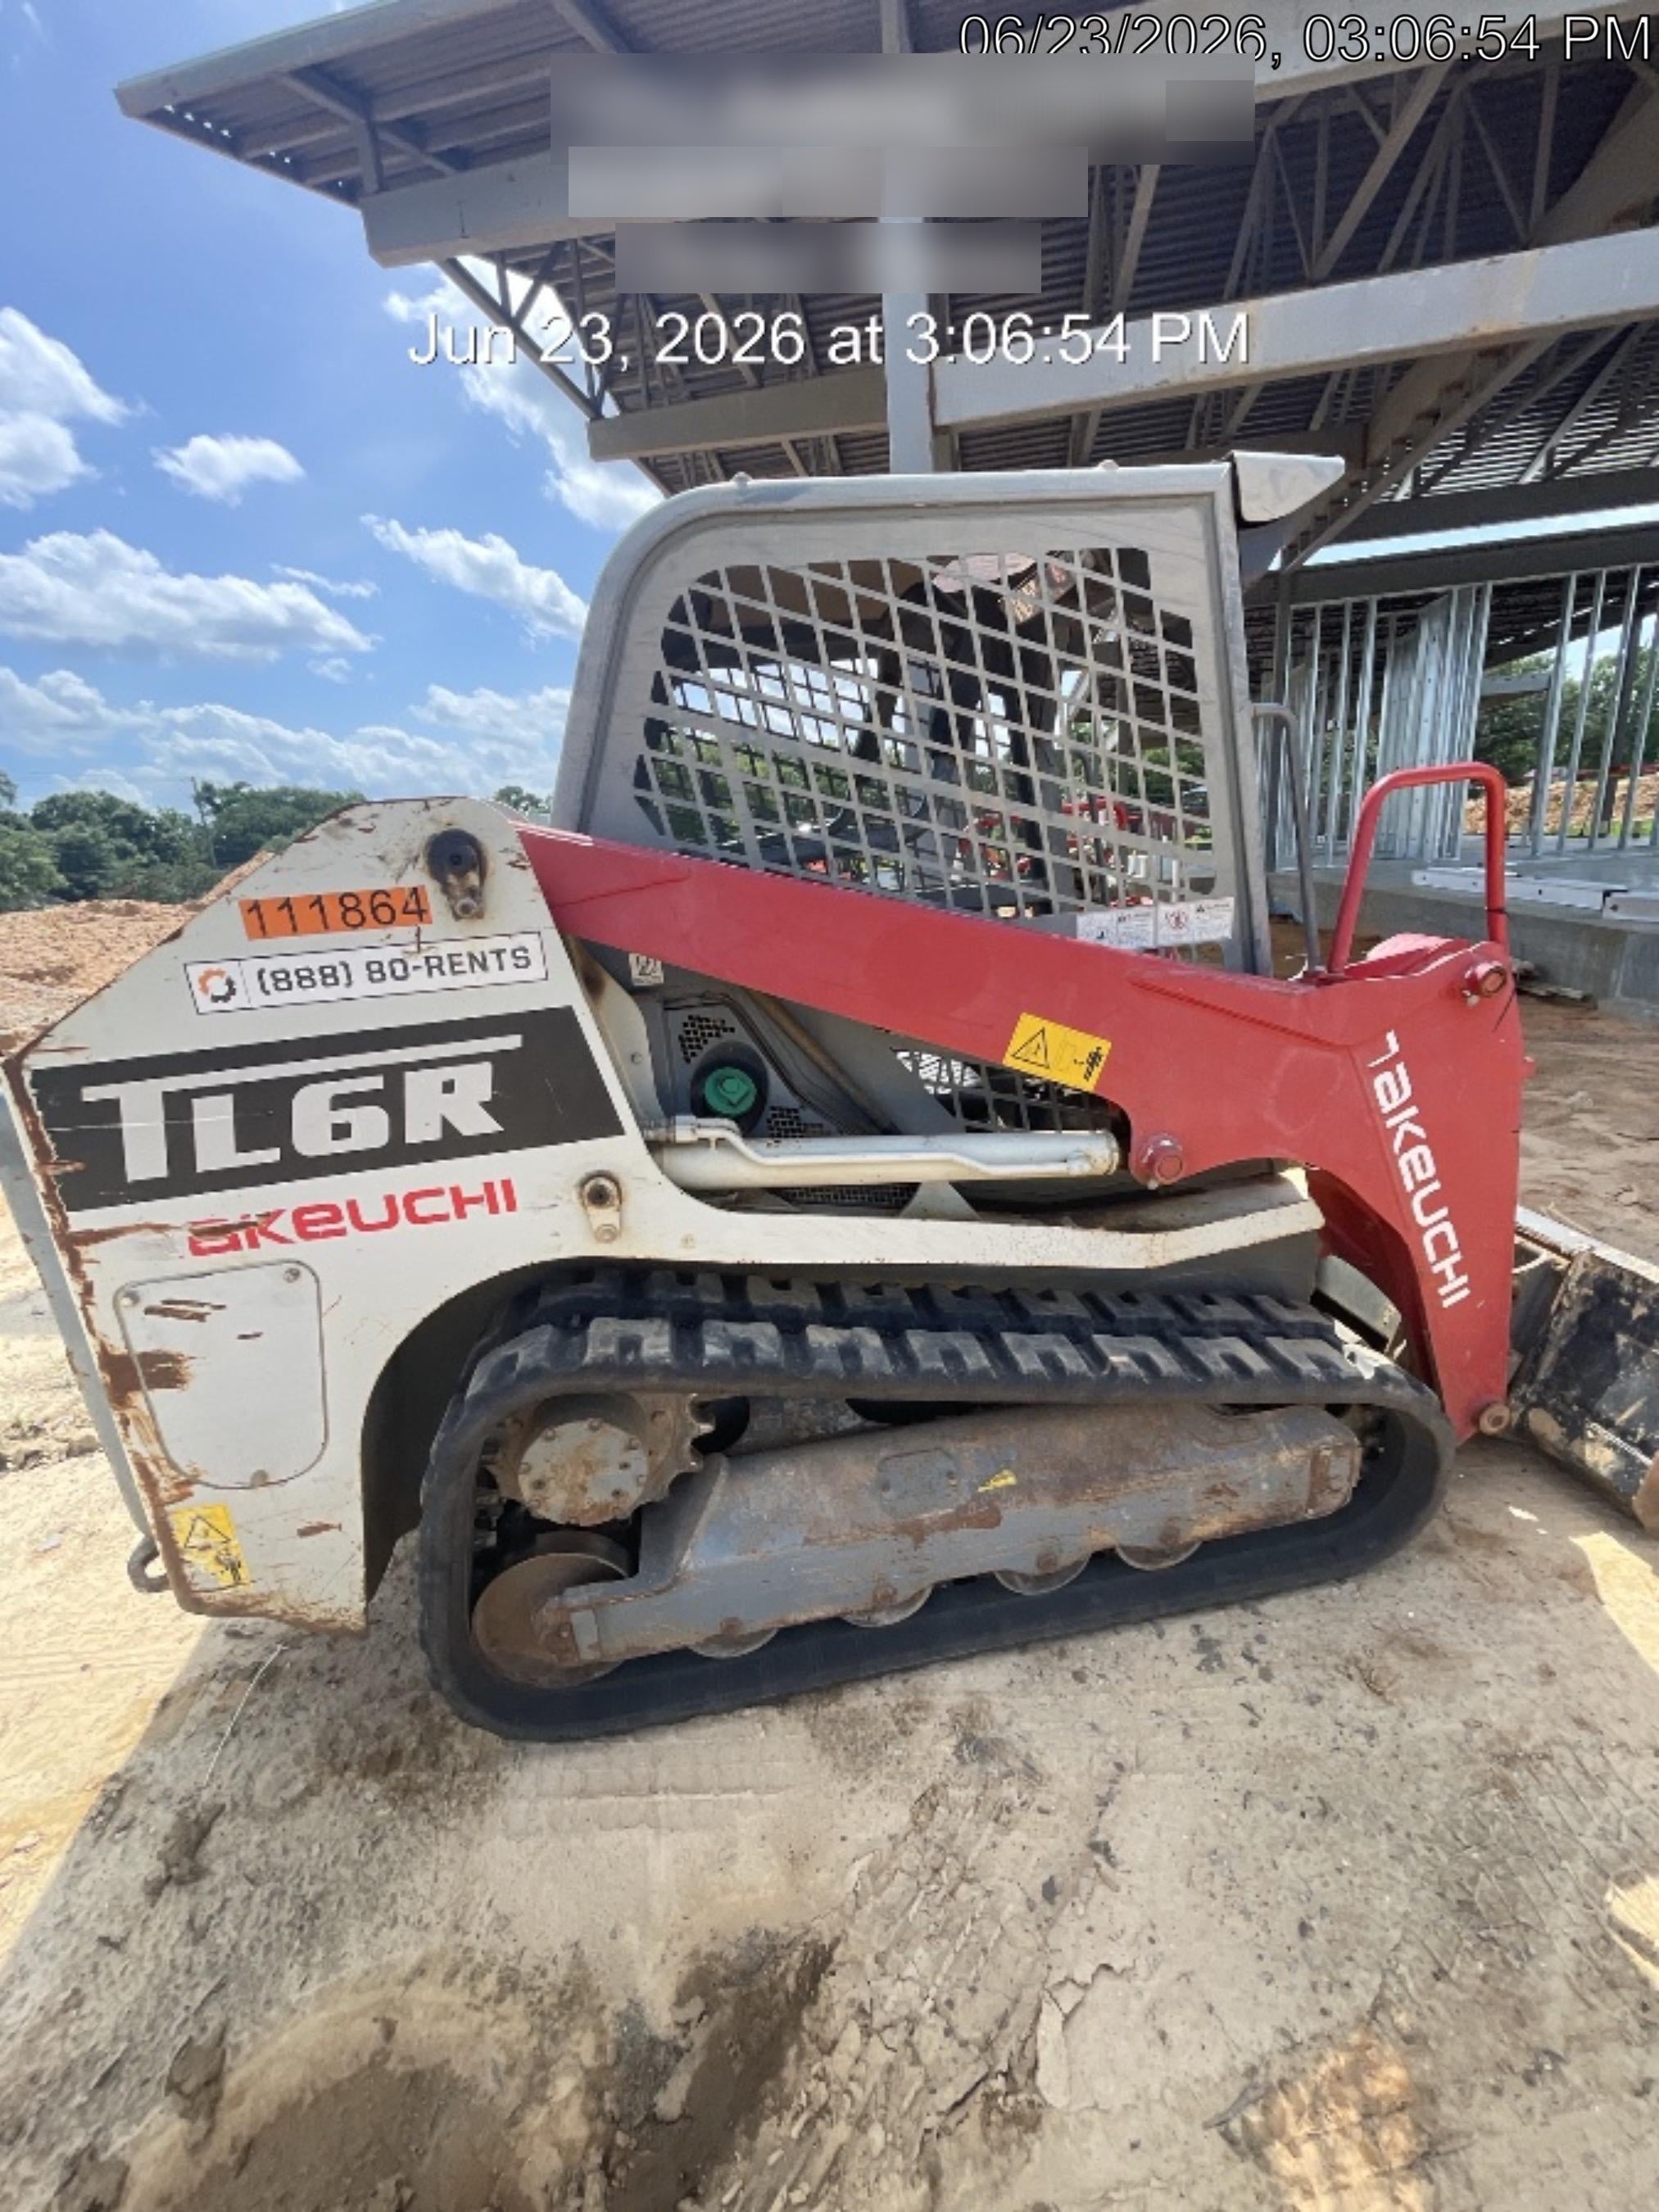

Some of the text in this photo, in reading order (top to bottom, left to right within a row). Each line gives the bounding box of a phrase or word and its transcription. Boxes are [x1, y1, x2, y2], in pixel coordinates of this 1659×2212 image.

[247, 886, 428, 936] 111864
[257, 945, 532, 996] (888) 80-RENTS
[82, 1035, 522, 1184] TL6R
